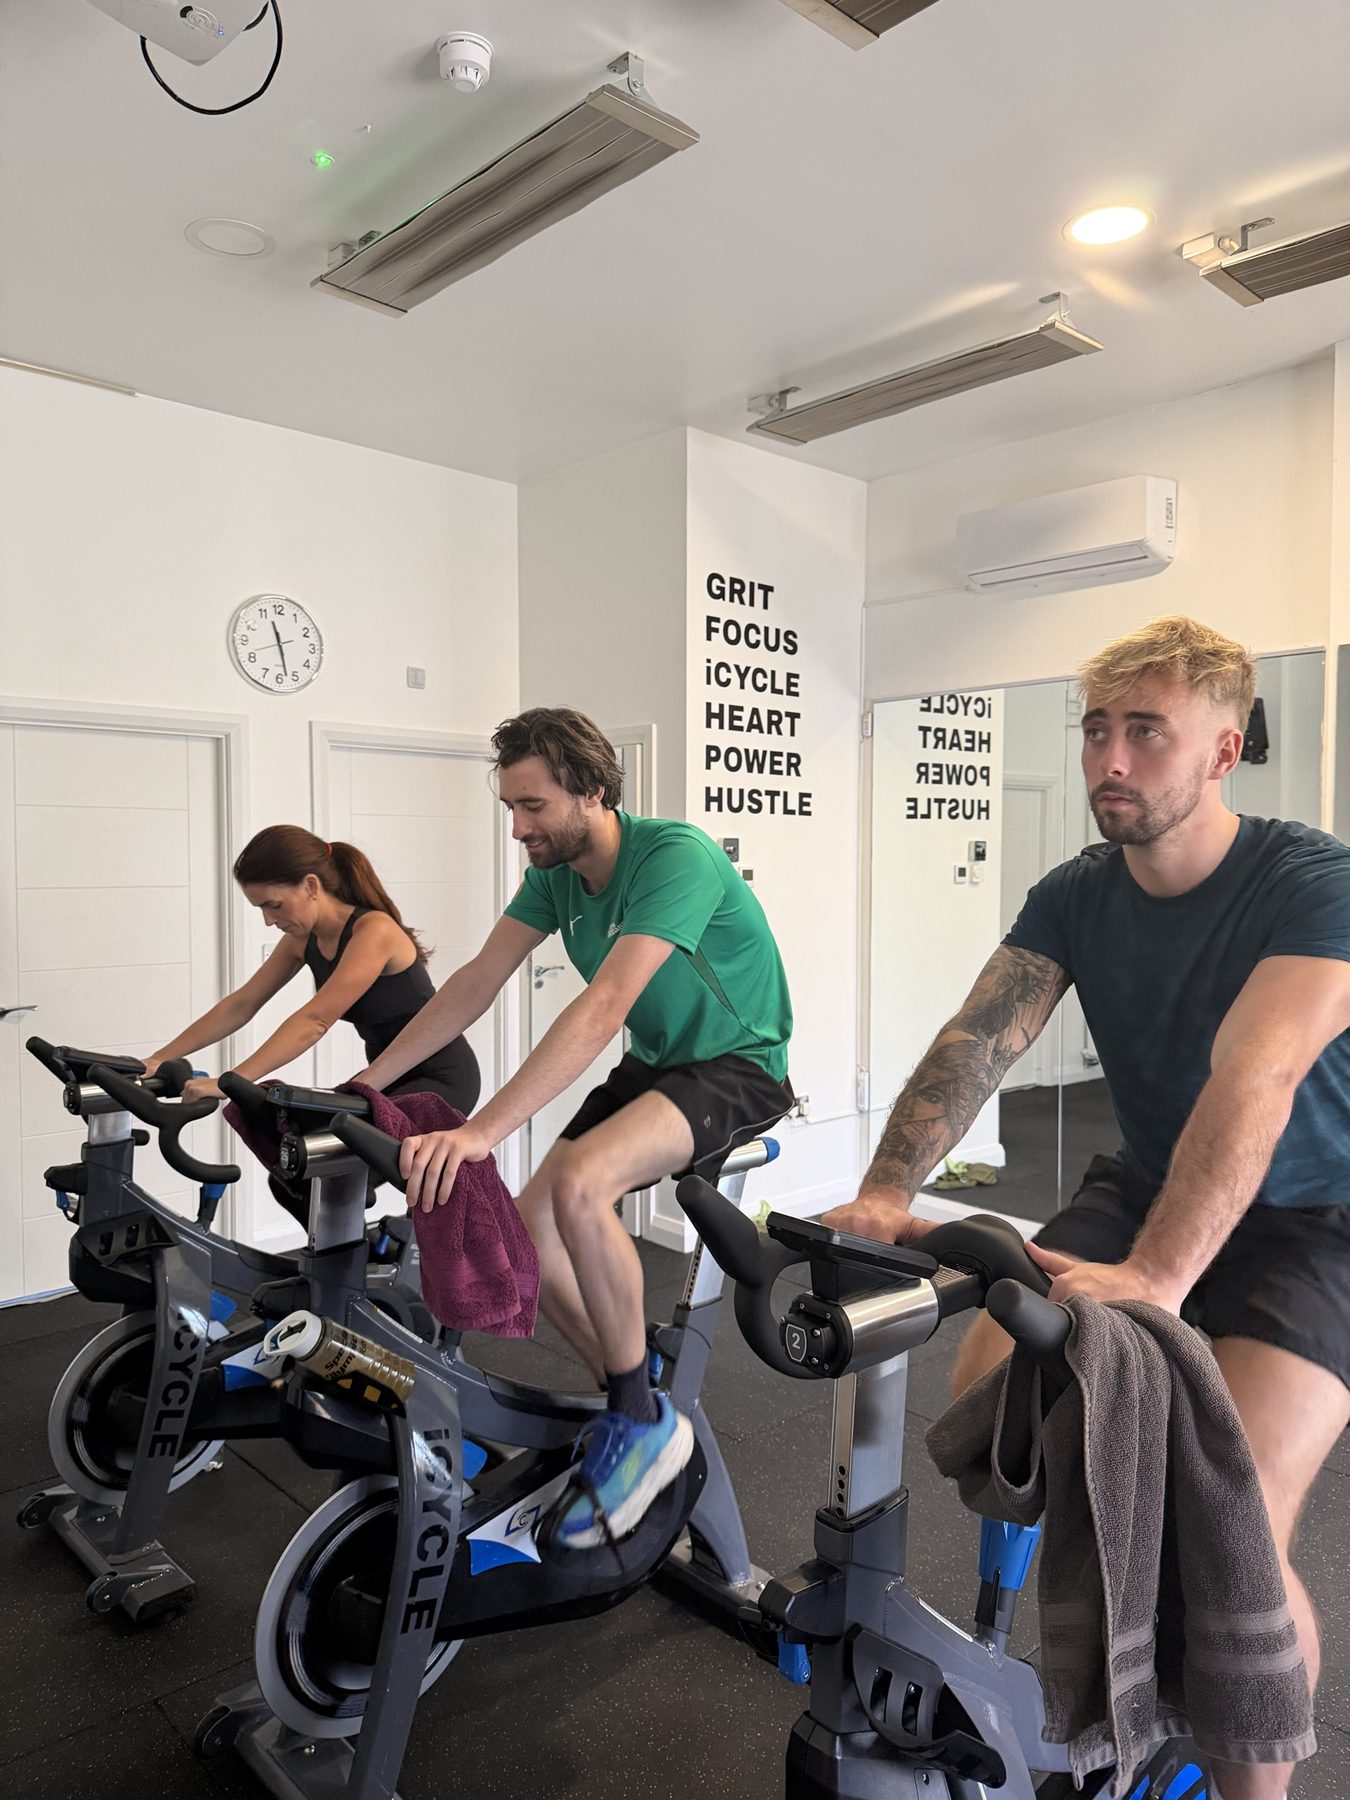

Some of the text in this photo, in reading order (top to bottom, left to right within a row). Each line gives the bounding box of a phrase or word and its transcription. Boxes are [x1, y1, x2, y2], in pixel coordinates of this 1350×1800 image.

[706, 573, 775, 610] GRIT
[258, 608, 268, 619] 11
[273, 604, 285, 616] 12
[293, 613, 298, 623] 1
[302, 627, 310, 638] 2
[706, 615, 799, 655] FOCUS
[240, 634, 249, 645] 9
[308, 643, 316, 654] 3
[247, 652, 257, 663] 8
[303, 659, 311, 669] 4
[261, 667, 270, 679] 7
[275, 673, 284, 684] 6
[291, 671, 300, 682] 5
[706, 658, 800, 697] iCYCLE
[705, 701, 801, 737] HEART
[705, 744, 802, 777] POWER
[704, 786, 812, 816] HUSTLE
[792, 1333, 801, 1349] 2
[148, 1313, 200, 1458] CYCLE
[400, 1428, 452, 1635] iCYCLE
